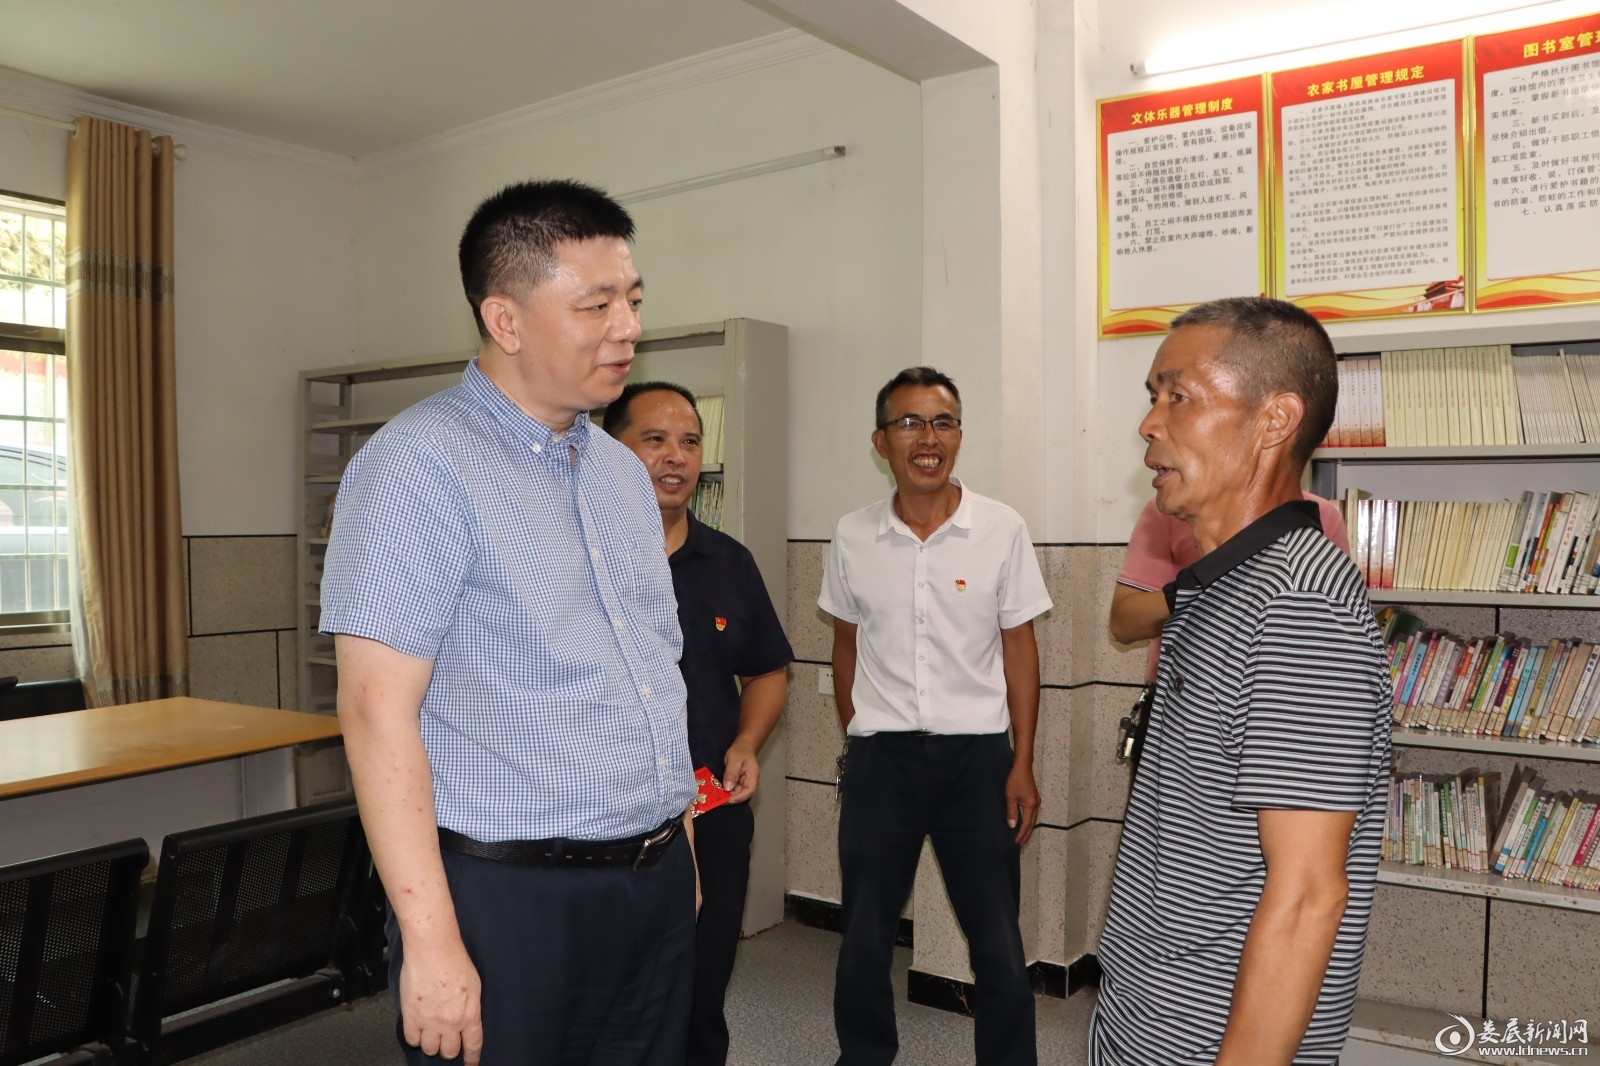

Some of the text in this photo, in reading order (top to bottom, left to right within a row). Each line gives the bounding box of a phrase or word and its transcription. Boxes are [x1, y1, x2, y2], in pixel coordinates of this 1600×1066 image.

[1524, 30, 1600, 58] 图书室管
[1306, 65, 1424, 97] 农家书屋管理规定
[1132, 98, 1232, 124] 文体乐器管理制度
